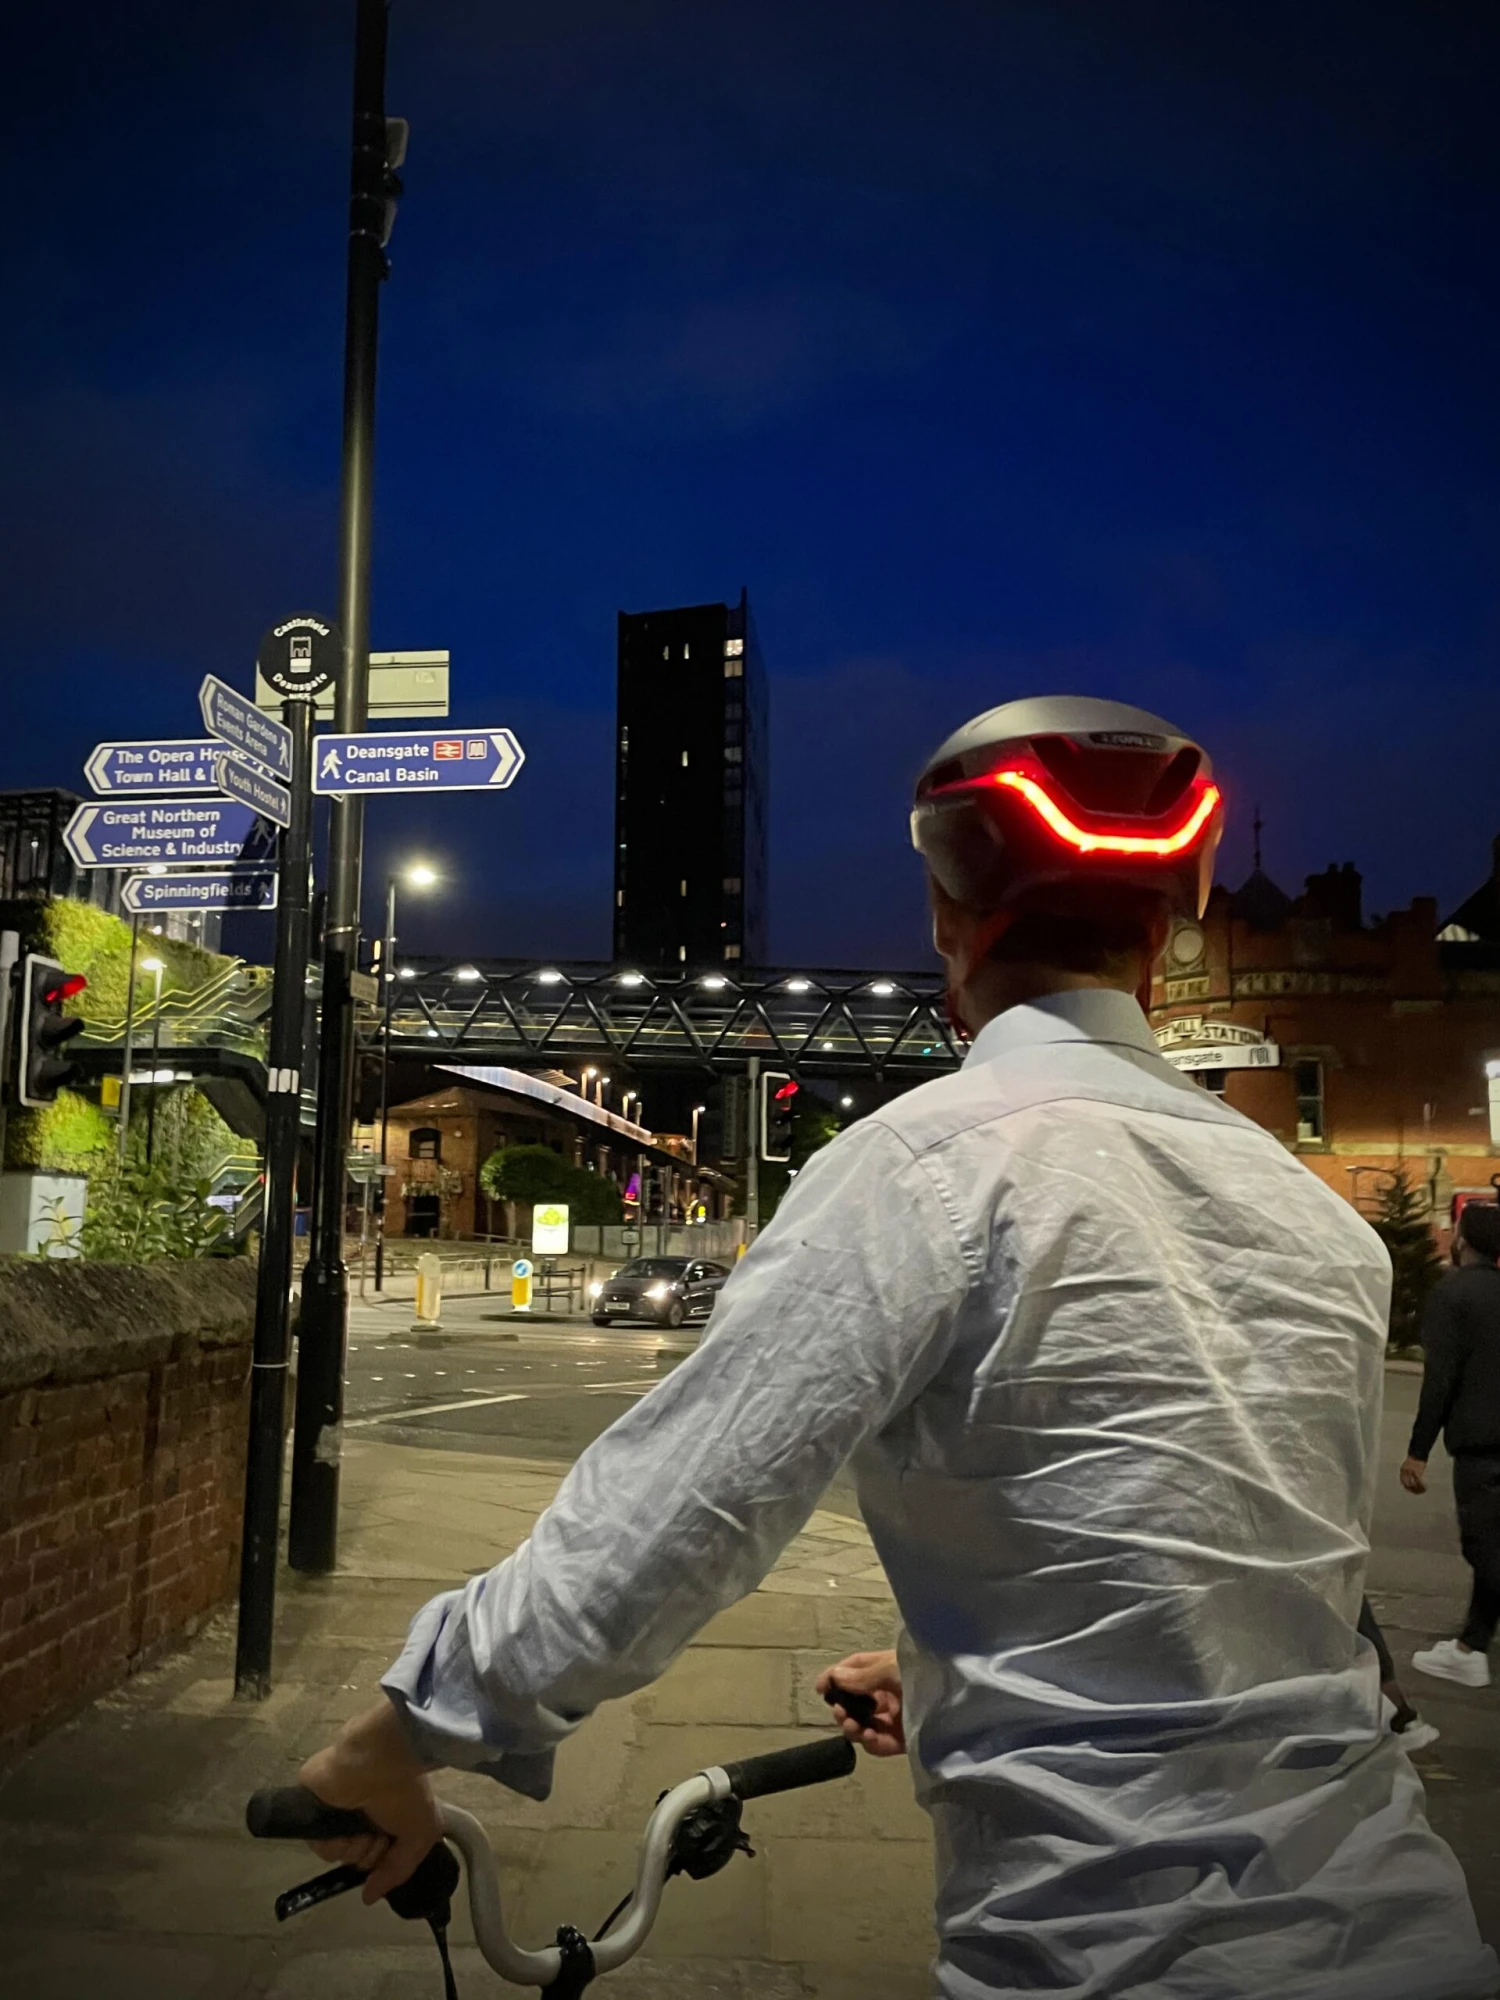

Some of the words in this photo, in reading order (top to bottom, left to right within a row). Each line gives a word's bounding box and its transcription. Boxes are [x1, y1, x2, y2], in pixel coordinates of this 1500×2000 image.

[273, 618, 330, 637] Castlefield
[272, 673, 328, 691] Deansgate
[217, 692, 245, 722] Roman
[216, 711, 244, 741] Events
[245, 731, 267, 756] Arena
[116, 750, 144, 765] The
[148, 749, 195, 765] Opera
[346, 743, 430, 760] Deansgate
[114, 770, 154, 784] Town
[158, 768, 191, 782] Hall
[194, 767, 206, 781] &
[345, 768, 391, 783] Canal
[395, 767, 439, 782] Basin
[228, 767, 252, 795] Youth
[253, 783, 279, 810] Hostel
[103, 810, 147, 825] Great
[151, 809, 221, 823] Northern
[131, 826, 195, 840] Museum
[199, 824, 217, 838] of
[101, 843, 161, 857] Science
[165, 842, 177, 855] &
[181, 841, 245, 856] Industry
[143, 883, 252, 901] Spinningfields
